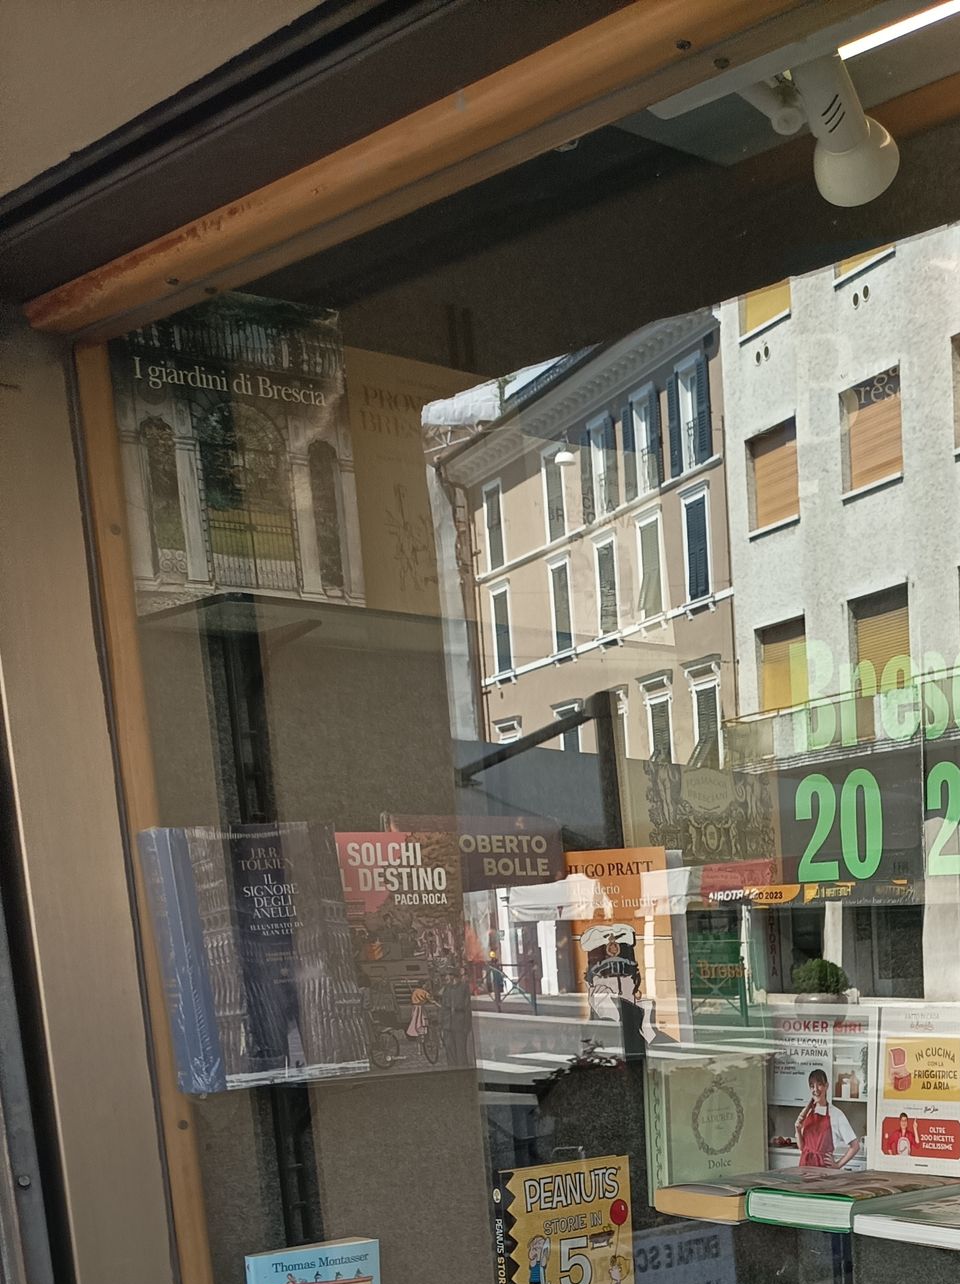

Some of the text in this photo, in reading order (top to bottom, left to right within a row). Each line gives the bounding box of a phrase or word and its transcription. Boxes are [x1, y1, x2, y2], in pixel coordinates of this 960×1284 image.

[133, 357, 326, 407] I giardini di Brescia
[795, 769, 883, 883] 20
[459, 834, 548, 855] OBERTO
[347, 842, 422, 868] SOLCHI
[484, 857, 549, 877] BOLLE
[608, 860, 653, 876] PRATT
[243, 882, 299, 896] SIGNORE
[262, 874, 276, 884] IL
[358, 868, 447, 892] DESTINO
[253, 894, 290, 907] DEGLI
[253, 905, 297, 918] ANELLI
[913, 1069, 958, 1081] FRIGGITRICE
[921, 1080, 950, 1091] AD ARIA
[707, 1158, 731, 1168] Dolce
[524, 1167, 619, 1213] PEANUTS
[543, 1211, 602, 1235] STORIE IN
[272, 1251, 368, 1275] Thomas Montasser
